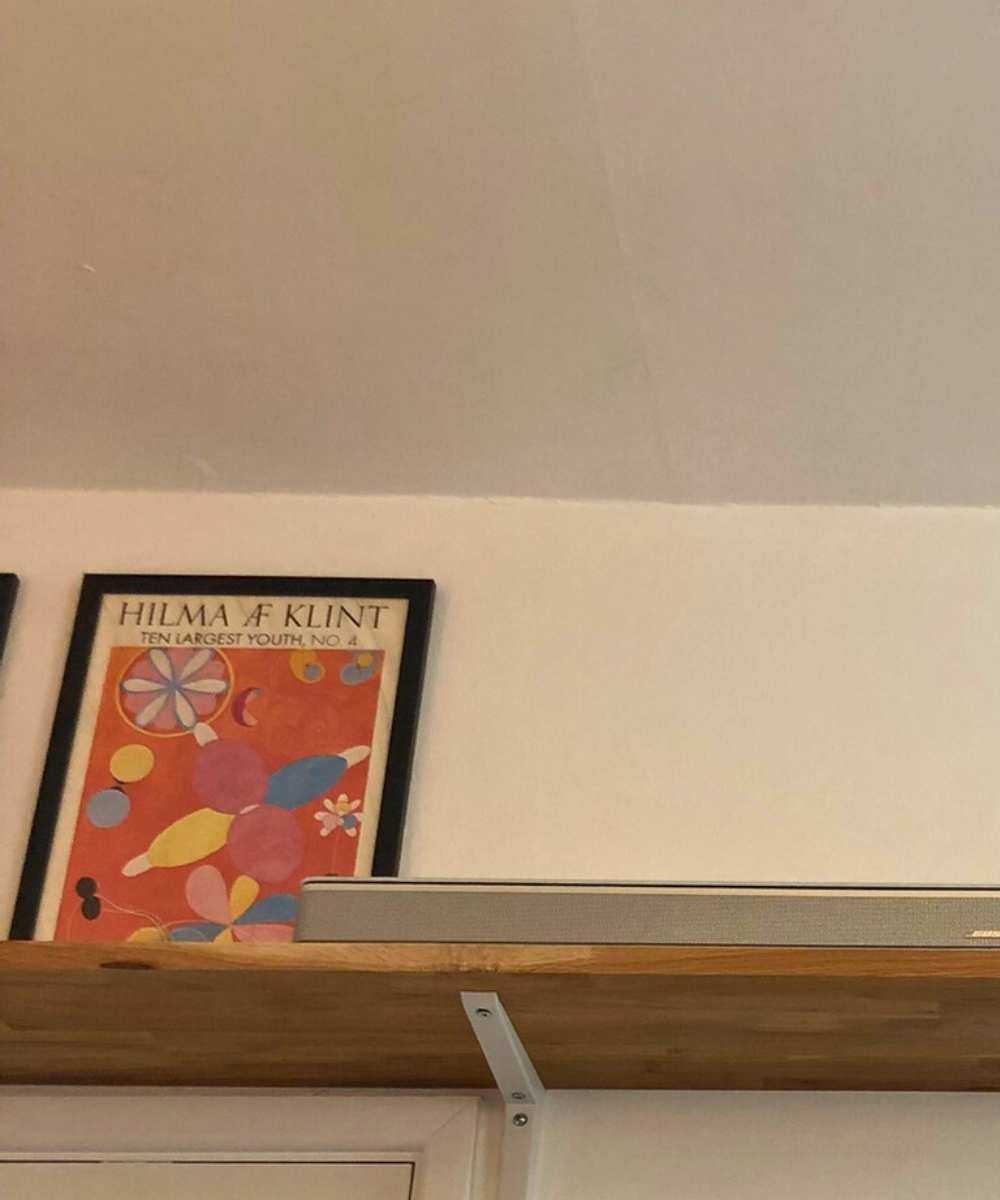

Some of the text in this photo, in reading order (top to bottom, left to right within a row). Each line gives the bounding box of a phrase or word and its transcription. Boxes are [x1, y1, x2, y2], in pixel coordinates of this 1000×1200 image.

[119, 602, 229, 627] HILMA
[284, 604, 390, 629] KLINT
[141, 631, 171, 644] TEN
[175, 632, 243, 646] LARGEST
[247, 633, 306, 647] YOUTH,
[347, 635, 358, 646] 4
